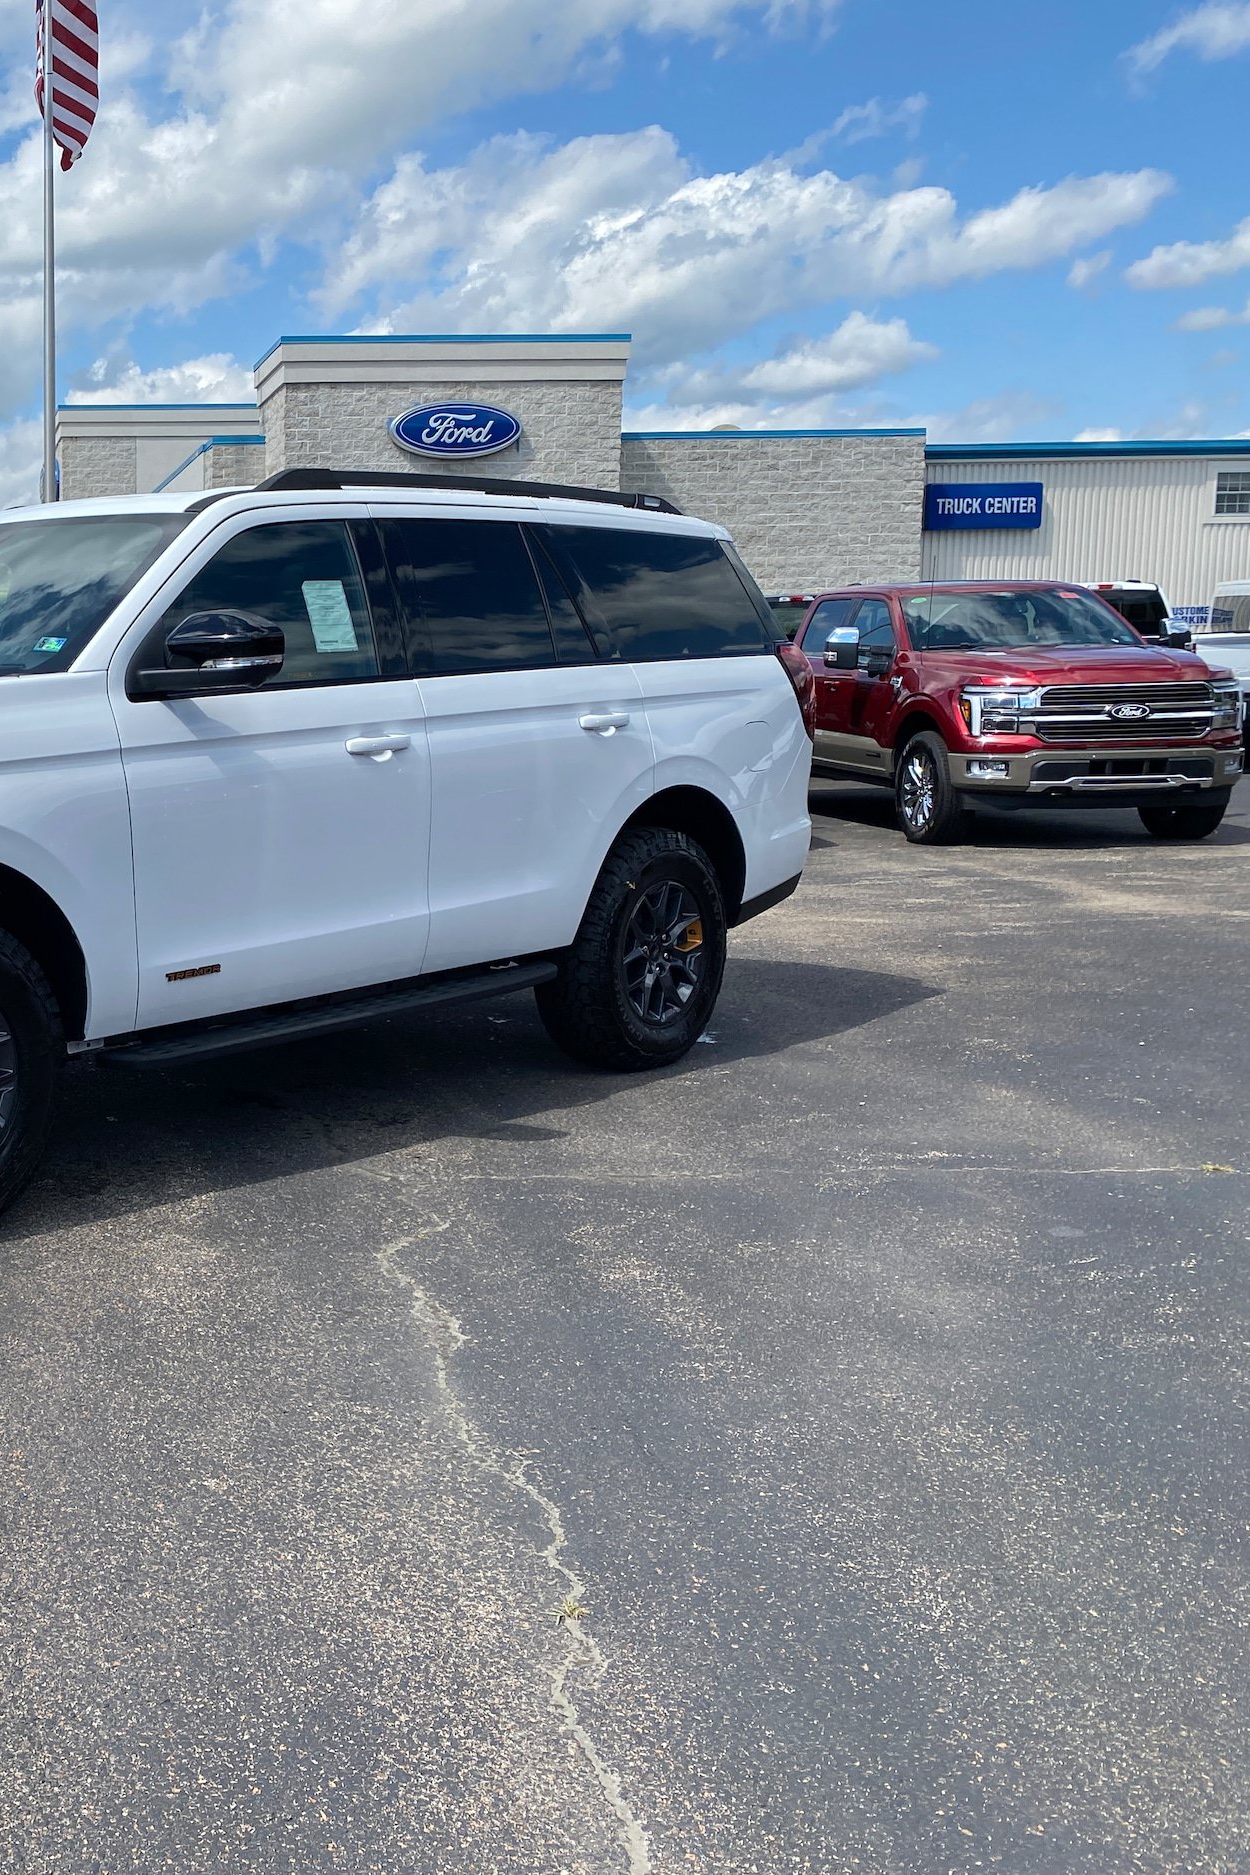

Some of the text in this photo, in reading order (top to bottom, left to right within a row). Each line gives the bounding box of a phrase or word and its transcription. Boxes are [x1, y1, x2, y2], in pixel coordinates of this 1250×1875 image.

[421, 413, 494, 444] Ford
[937, 497, 1036, 514] TRUCK CENTER
[1172, 606, 1209, 615] USTOME
[1119, 706, 1142, 716] Ford
[165, 963, 221, 982] TREMOR
